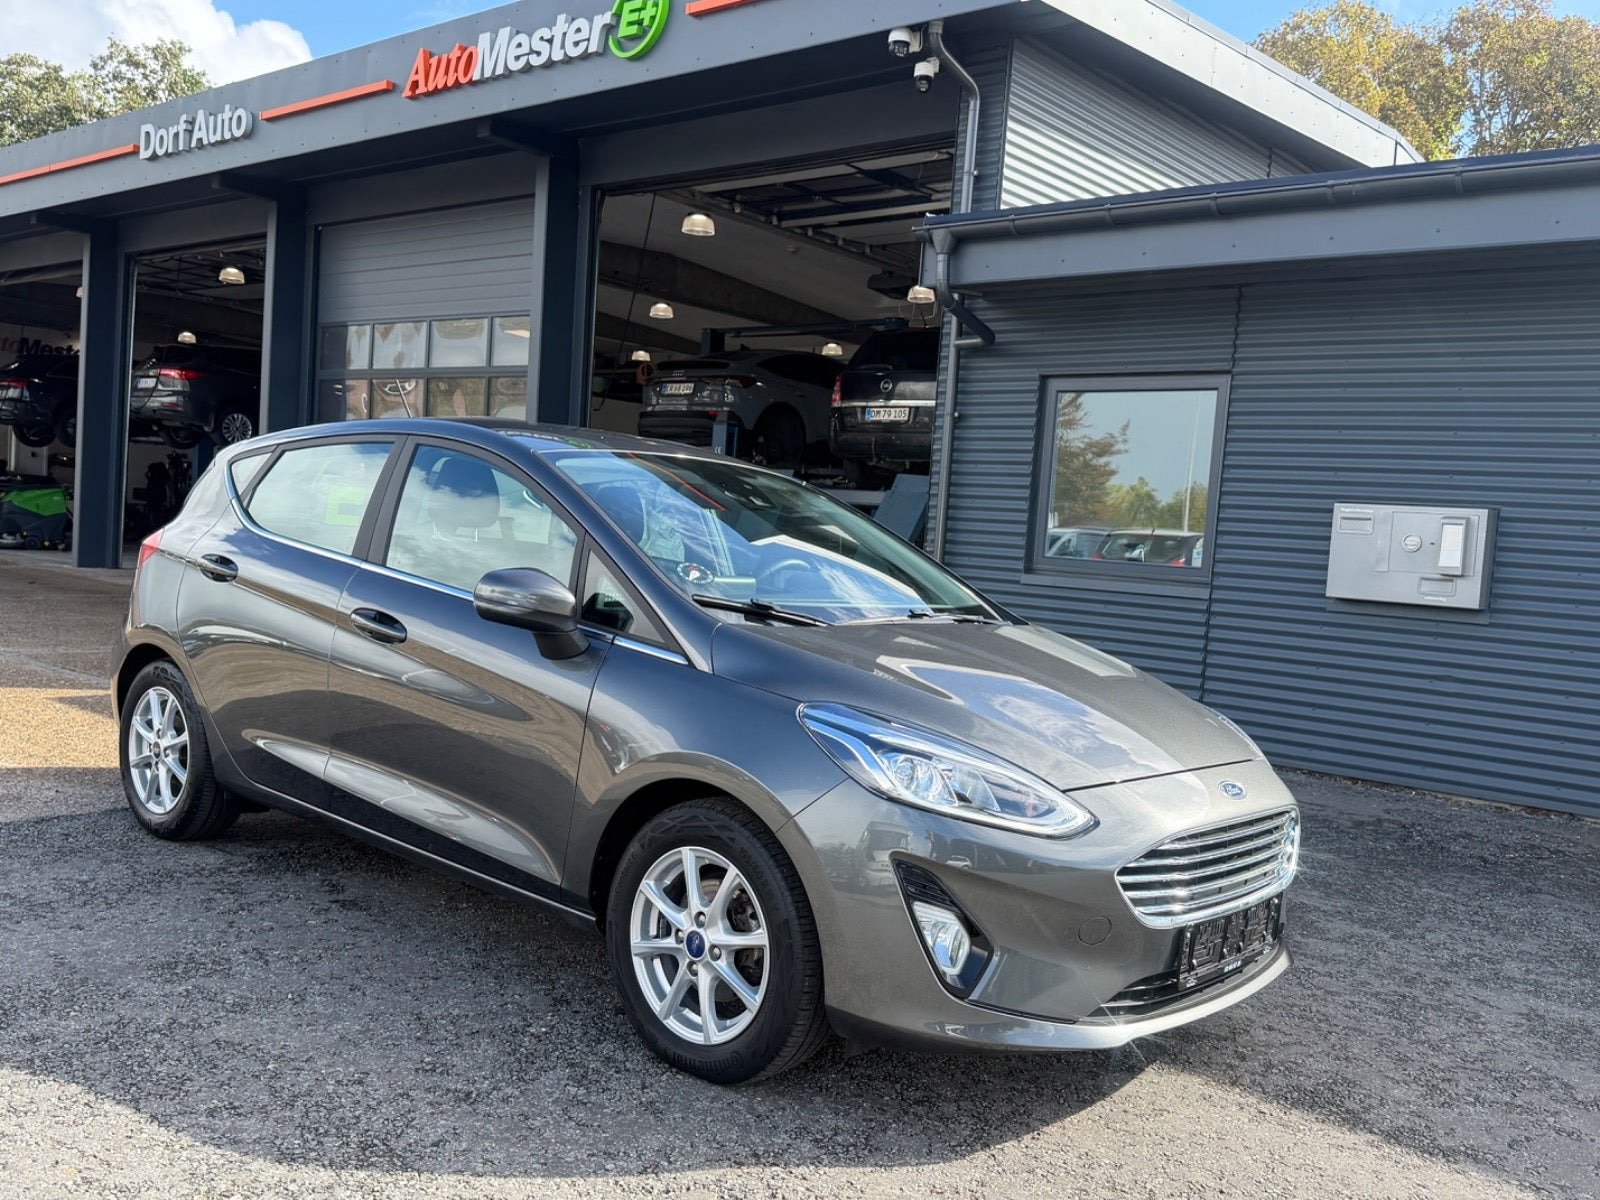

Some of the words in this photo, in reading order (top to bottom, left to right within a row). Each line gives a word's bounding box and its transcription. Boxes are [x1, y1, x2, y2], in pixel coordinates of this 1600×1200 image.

[402, 11, 616, 99] AutoMester
[139, 113, 191, 160] Dorf
[190, 103, 252, 149] Auto
